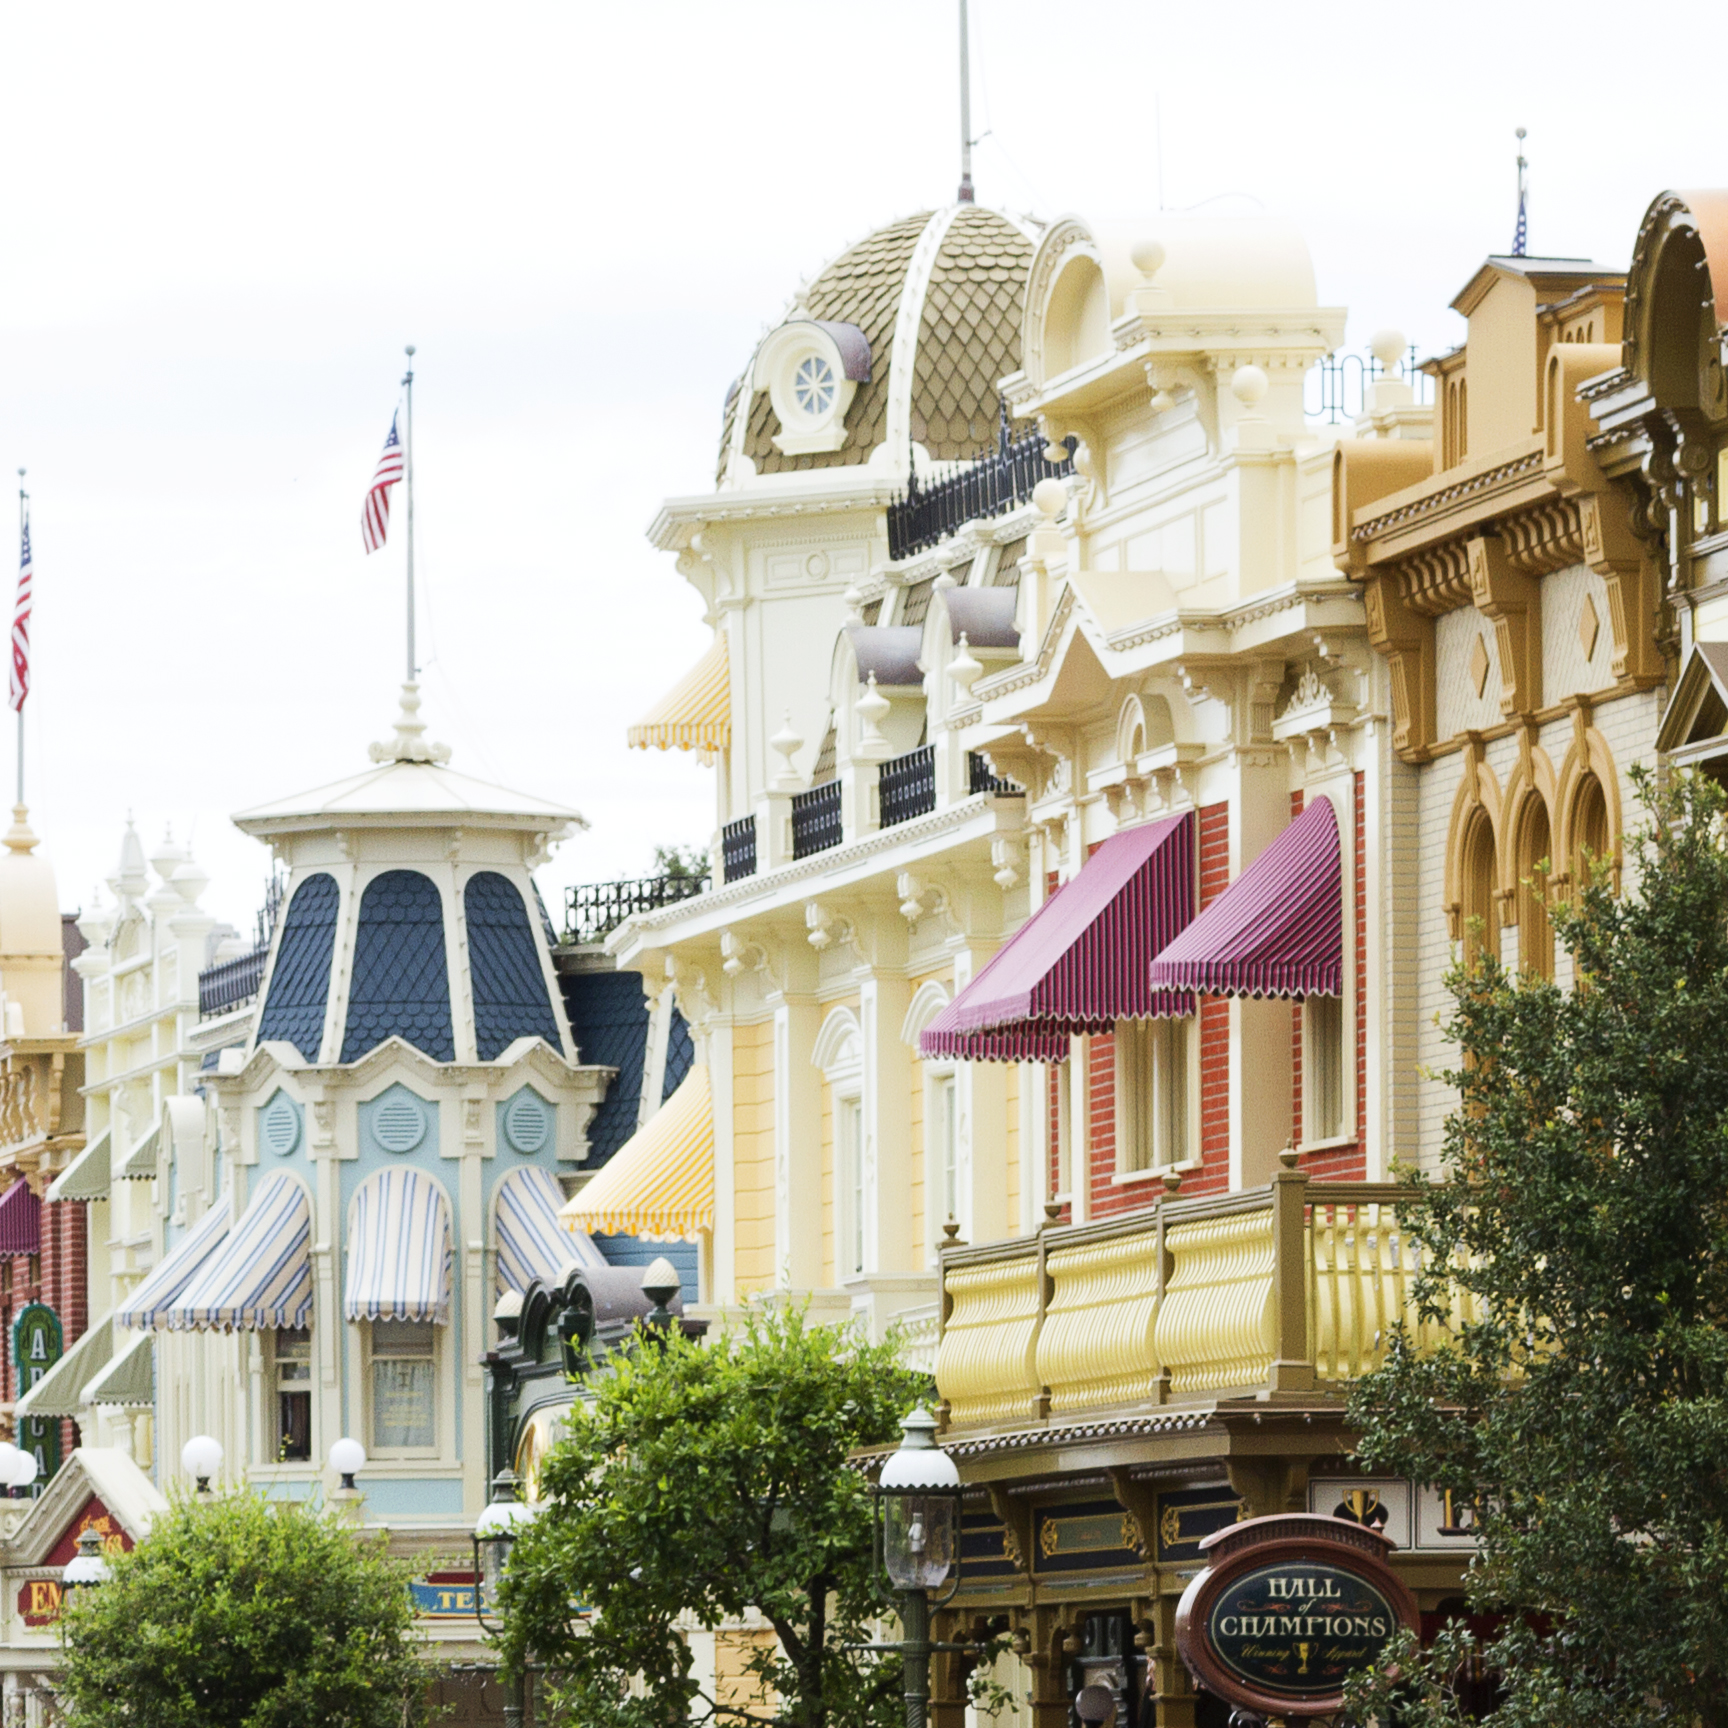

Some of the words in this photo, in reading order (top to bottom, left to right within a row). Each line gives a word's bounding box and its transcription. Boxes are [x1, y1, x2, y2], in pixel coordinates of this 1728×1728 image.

[1268, 1578, 1341, 1599] HALL
[1298, 1598, 1316, 1615] of
[1220, 1616, 1386, 1637] CHAMPIONS
[1241, 1643, 1291, 1661] Winning
